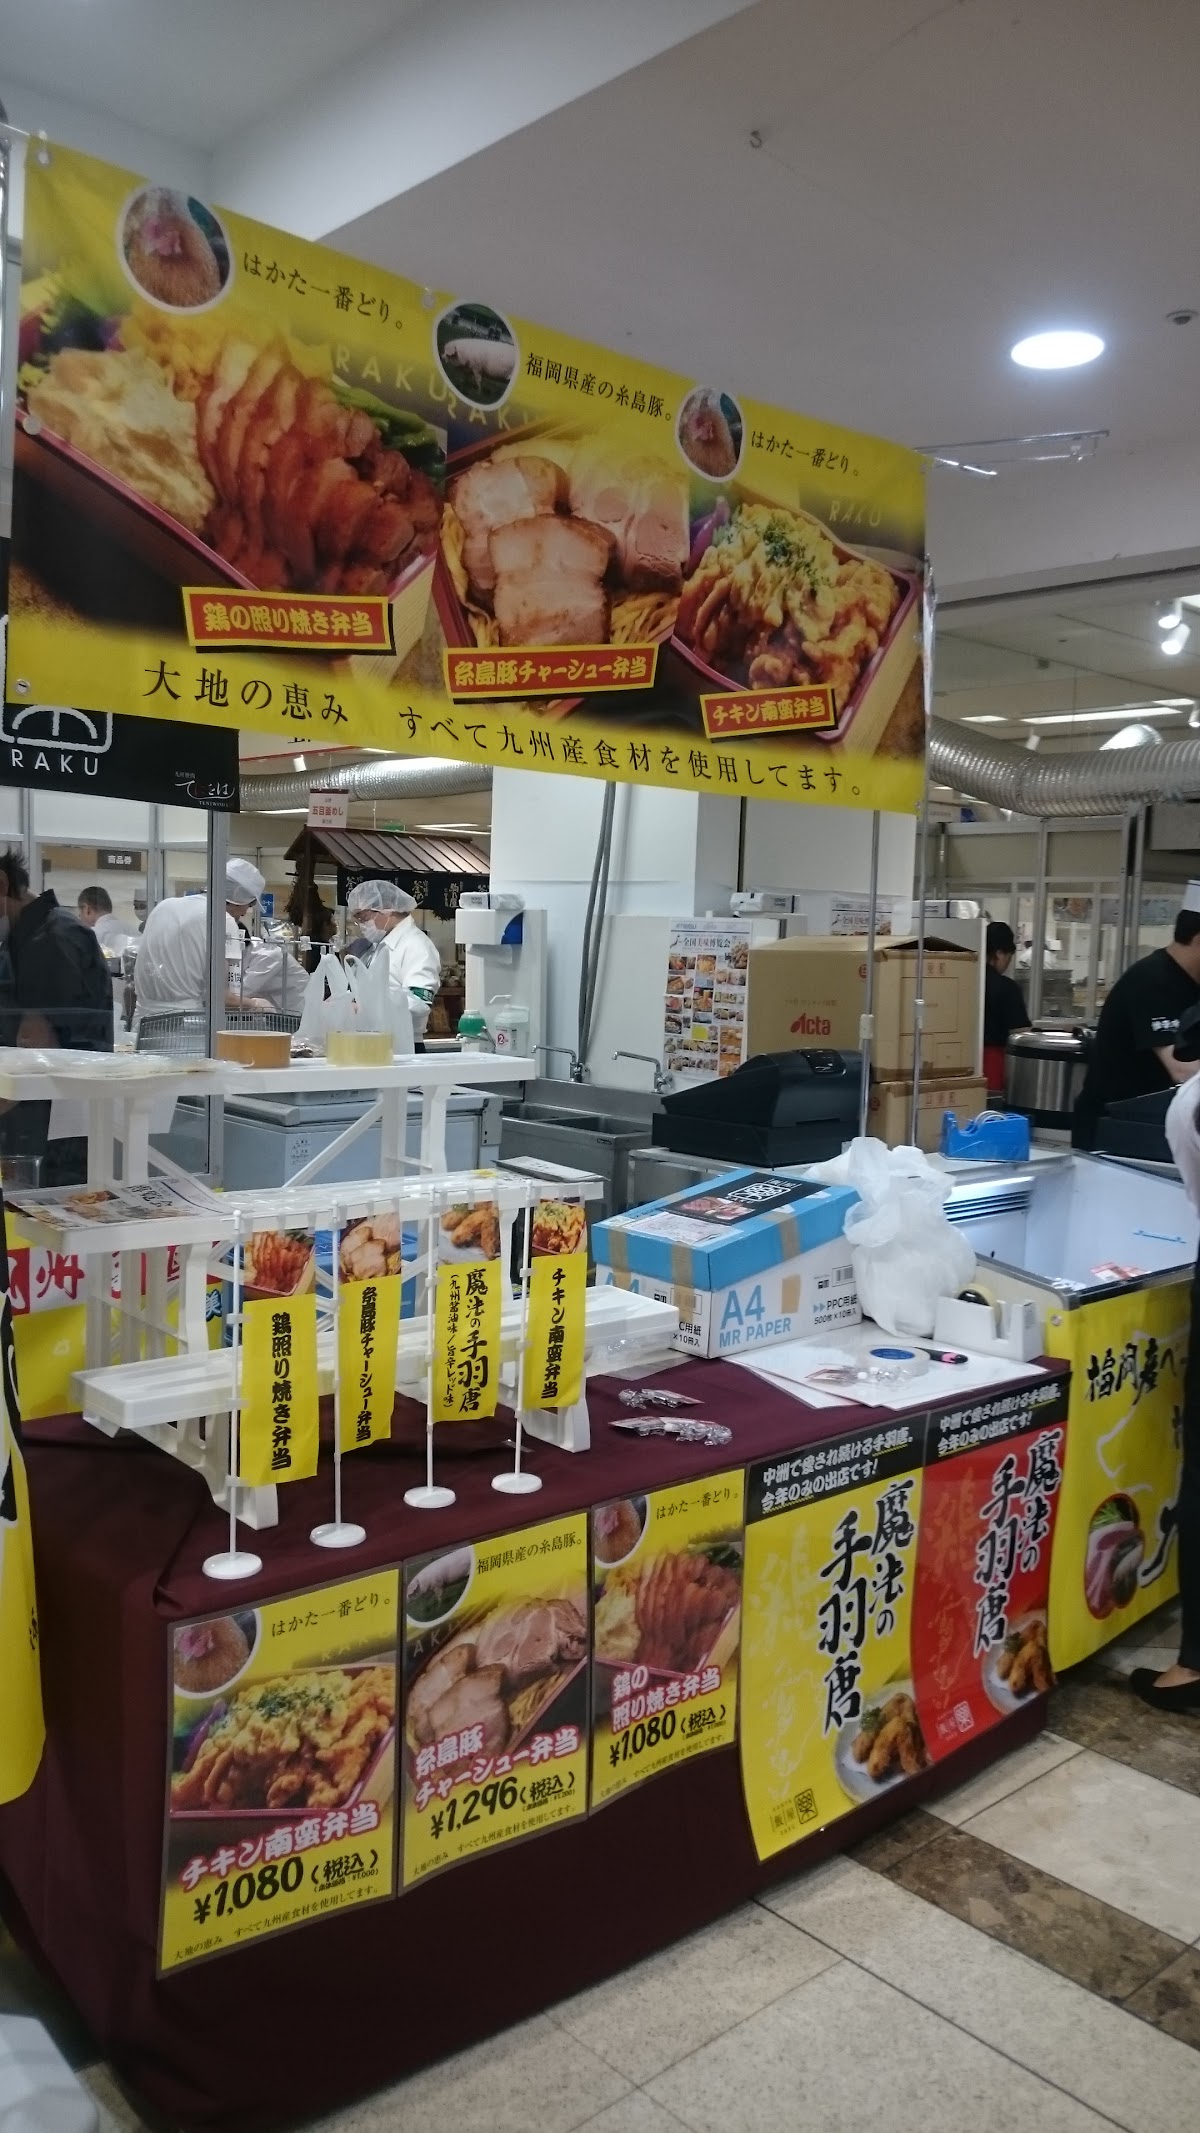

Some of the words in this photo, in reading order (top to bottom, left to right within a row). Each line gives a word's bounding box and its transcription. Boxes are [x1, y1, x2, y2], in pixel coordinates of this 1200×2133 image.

[243, 251, 404, 330] はかた一番どり。
[525, 352, 673, 422] 福岡県産の糸島豚。
[750, 431, 861, 478] はかた一番どり。
[203, 601, 374, 638] 鶏の照り焼き弁当
[453, 656, 648, 687] 糸島豚チャーシュー弁当
[142, 660, 349, 725] 大地の恵み
[397, 706, 862, 797] すべて九州産食材を使用してます。
[712, 696, 827, 727] チキン南蛮弁当
[11, 748, 99, 776] RAKU
[107, 855, 132, 865] 商品券
[790, 1012, 831, 1036] Acta
[540, 1267, 566, 1399] チキン南蛮弁当
[718, 1328, 742, 1349] MR
[746, 1317, 792, 1342] PAPER
[719, 1284, 766, 1330] A4
[271, 1311, 292, 1471] 鶏照り焼き弁当
[356, 1286, 378, 1443] 糸島豚チャーシュー弁当
[655, 1488, 740, 1521] はかた一番どり。
[1020, 1430, 1063, 1572] 魔法の
[476, 1531, 583, 1576] 福岡県産の糸島豚。
[870, 1478, 914, 1636] 魔法の
[270, 1592, 391, 1638] はかた一番どり。
[612, 1667, 722, 1733] 照り焼き弁当
[613, 1664, 649, 1701] 鶏の
[415, 1722, 485, 1780] 糸島豚
[415, 1726, 581, 1811] チャーシュー弁当
[609, 1710, 677, 1769] ¥1,080
[430, 1775, 518, 1840] ¥1,296
[181, 1802, 380, 1890] チキン南蛮弁当
[193, 1856, 305, 1925] ¥1,080
